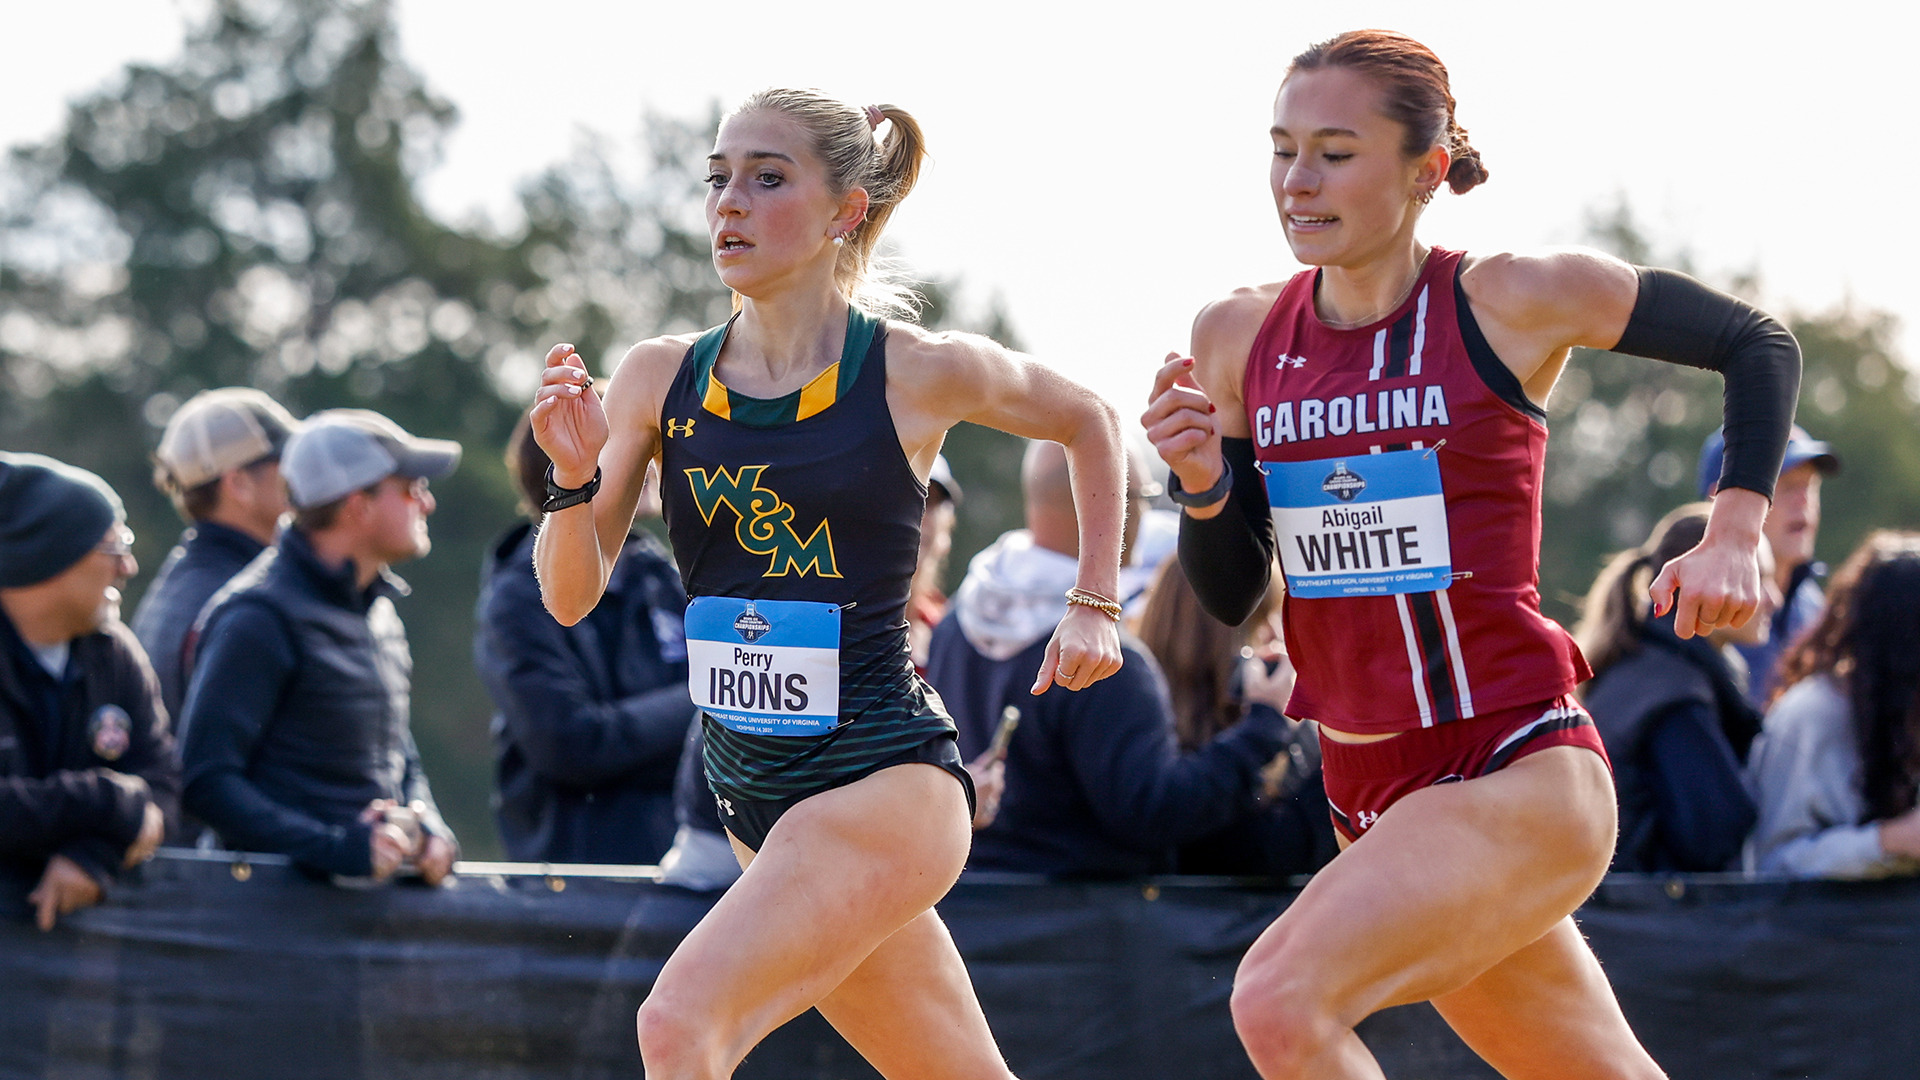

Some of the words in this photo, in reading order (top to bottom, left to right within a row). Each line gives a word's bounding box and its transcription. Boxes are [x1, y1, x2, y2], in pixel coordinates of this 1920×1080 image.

[1255, 385, 1450, 448] CAROLINA
[683, 464, 844, 578] W&M
[1322, 506, 1383, 530] Abigail
[1295, 525, 1422, 572] WHITE
[1296, 579, 1332, 587] SOUTHEAST
[1359, 576, 1394, 584] UNIVERSITY
[1404, 572, 1434, 581] VIRGINIA
[734, 647, 773, 671] Perry
[709, 667, 809, 712] IRONS
[748, 716, 781, 725] UNIVERSITY
